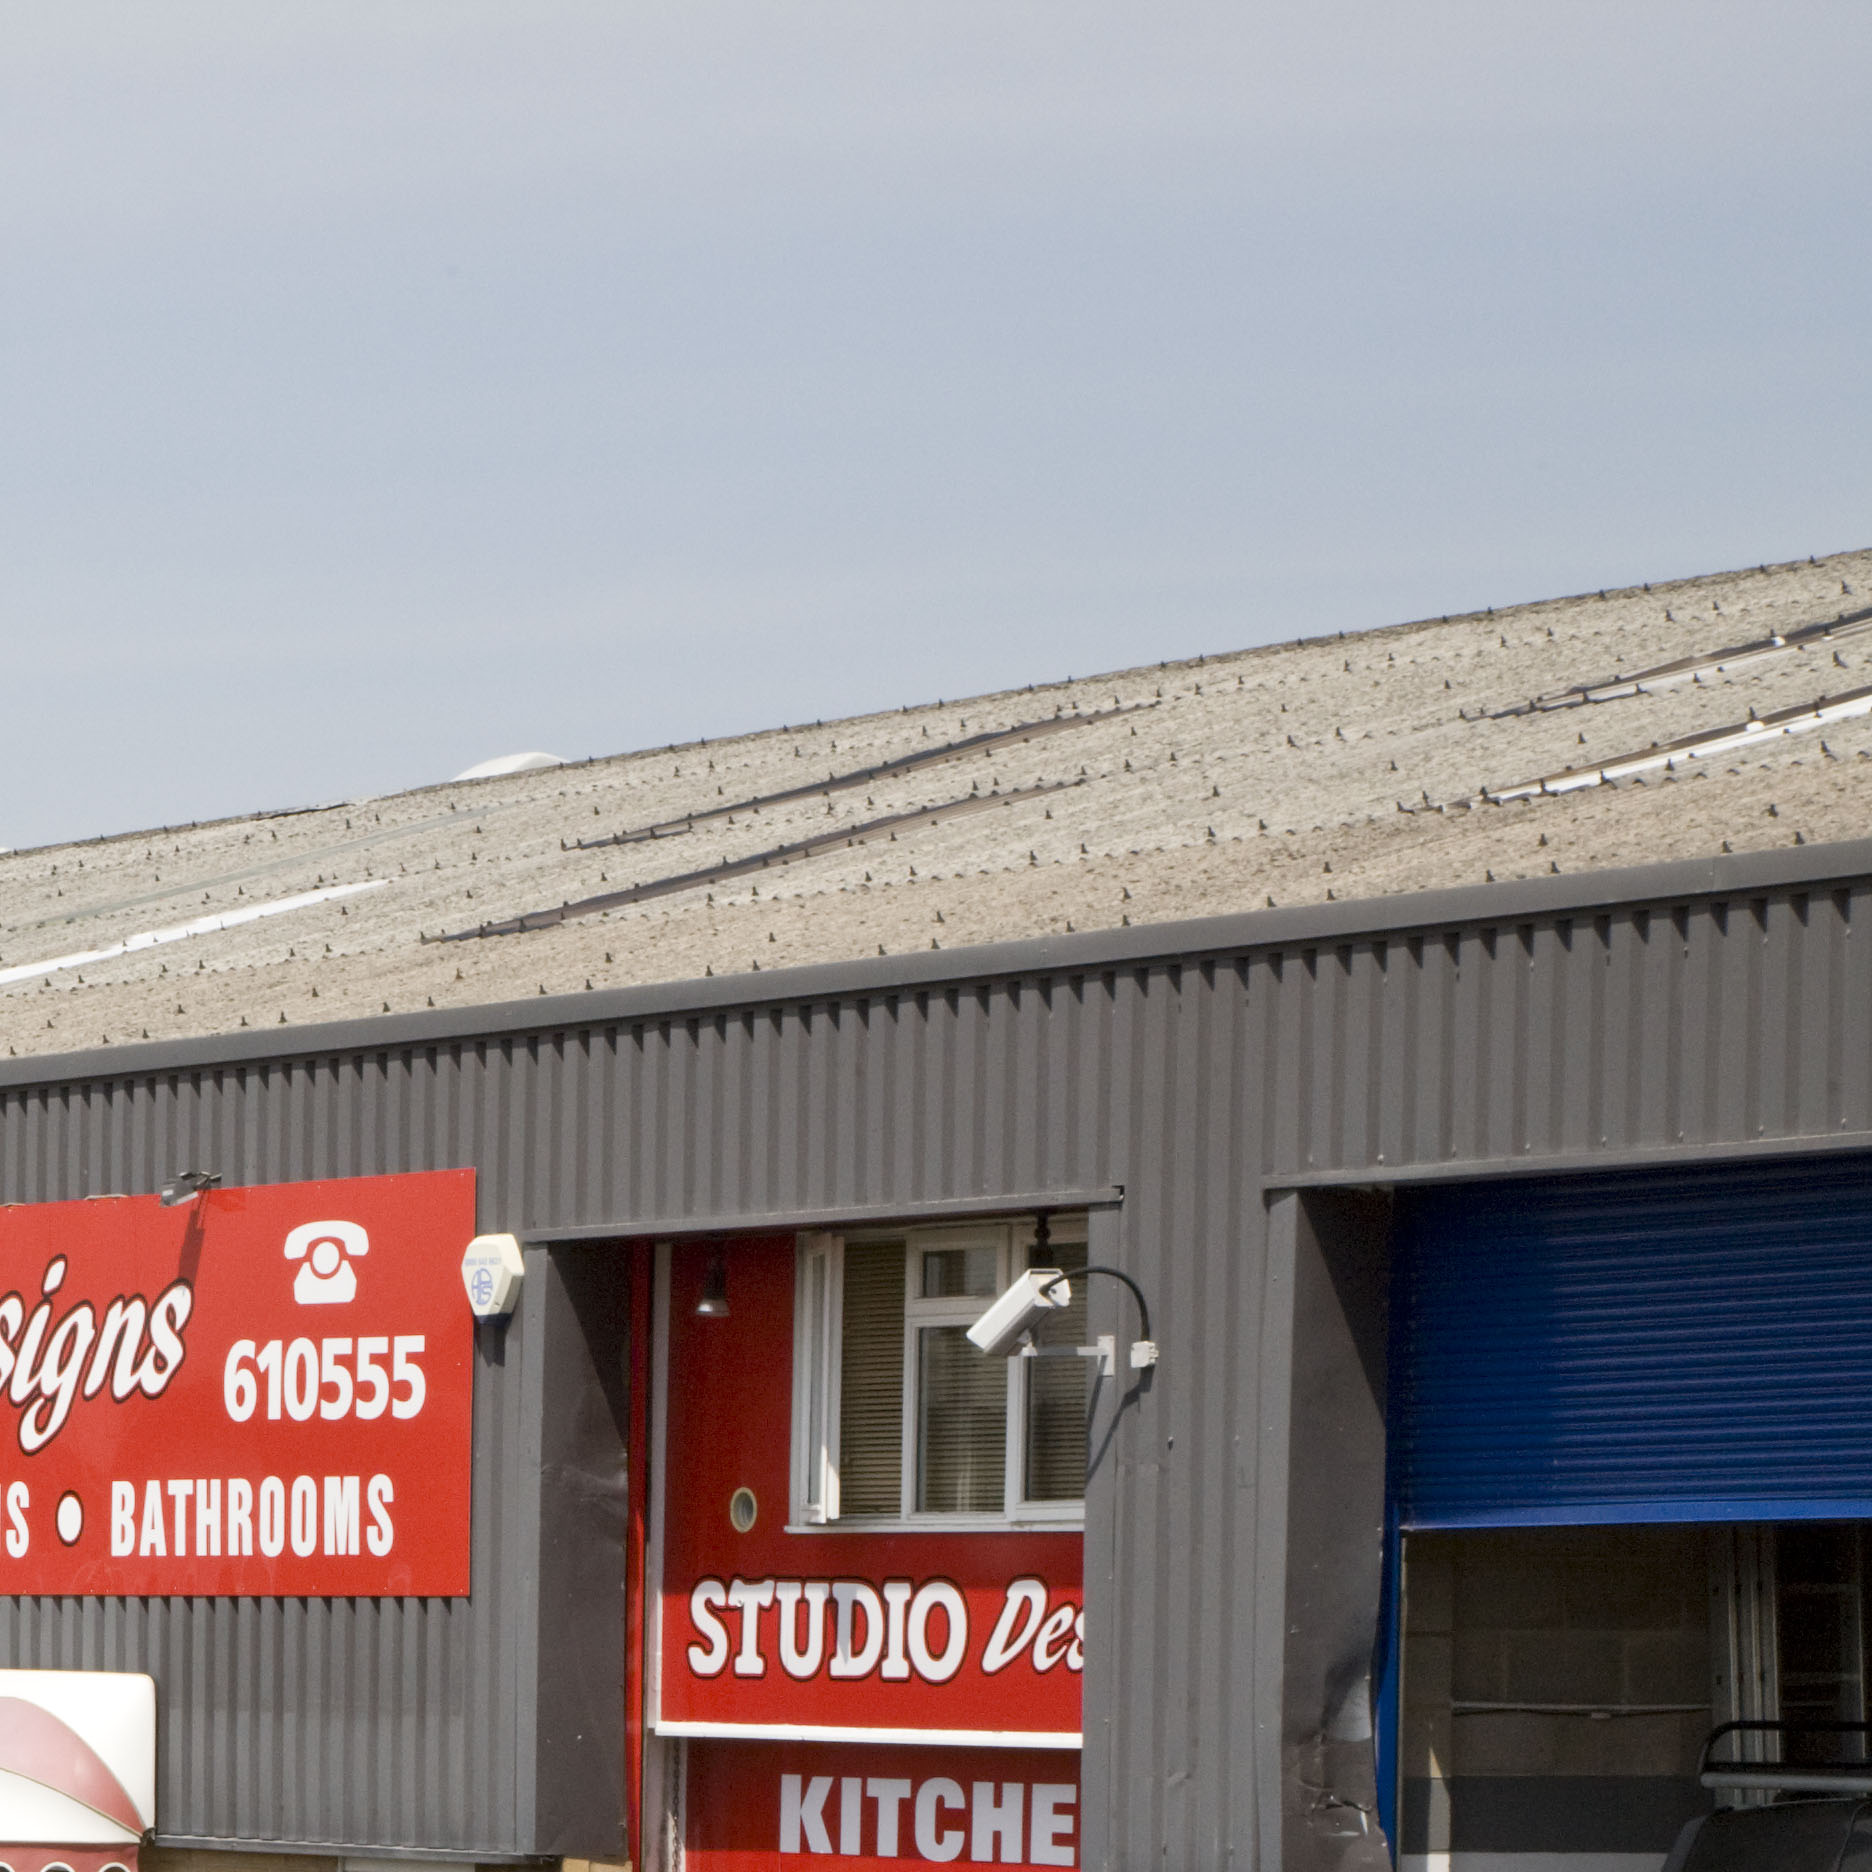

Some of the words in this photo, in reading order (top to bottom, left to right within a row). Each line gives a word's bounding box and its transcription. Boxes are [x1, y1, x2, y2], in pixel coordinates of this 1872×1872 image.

[223, 1334, 426, 1423] 610555
[110, 1473, 394, 1558] BATHROOMS
[687, 1577, 968, 1683] STUDIO
